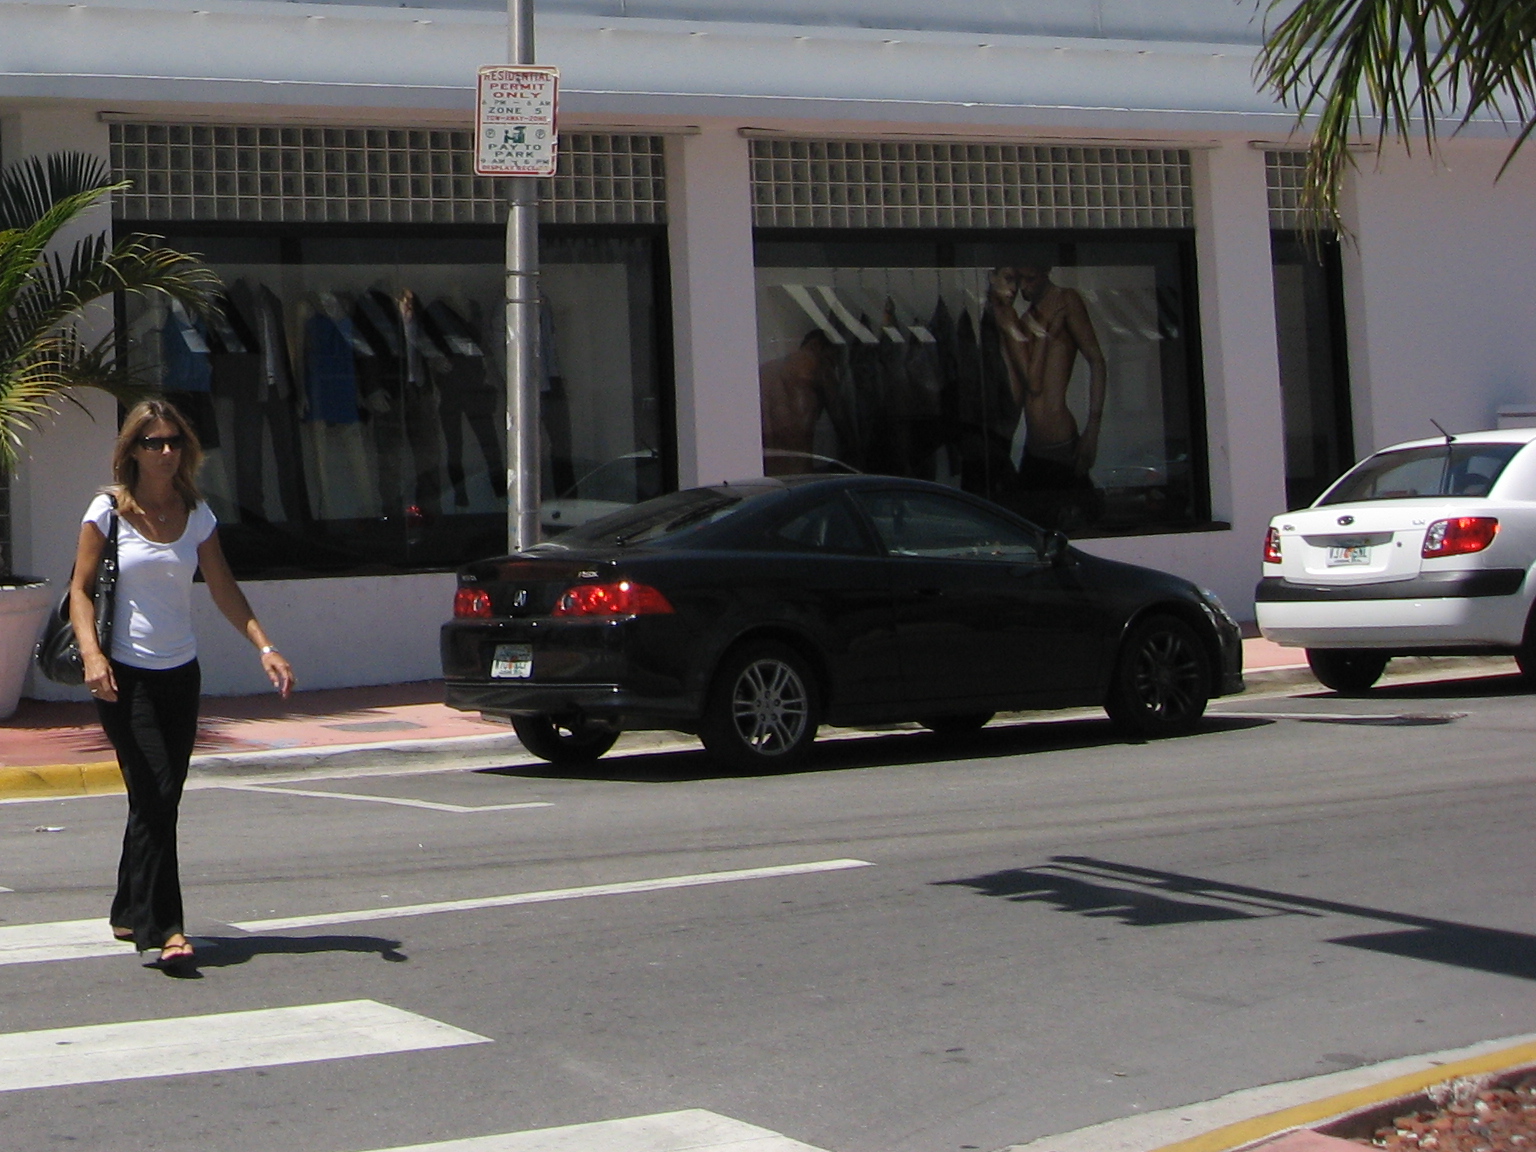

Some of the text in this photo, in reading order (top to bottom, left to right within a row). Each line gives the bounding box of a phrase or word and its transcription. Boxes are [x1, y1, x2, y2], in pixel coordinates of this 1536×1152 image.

[490, 82, 545, 91] PERMIT
[492, 91, 542, 99] ONLY
[488, 107, 522, 115] ZONE
[495, 150, 534, 158] PARK
